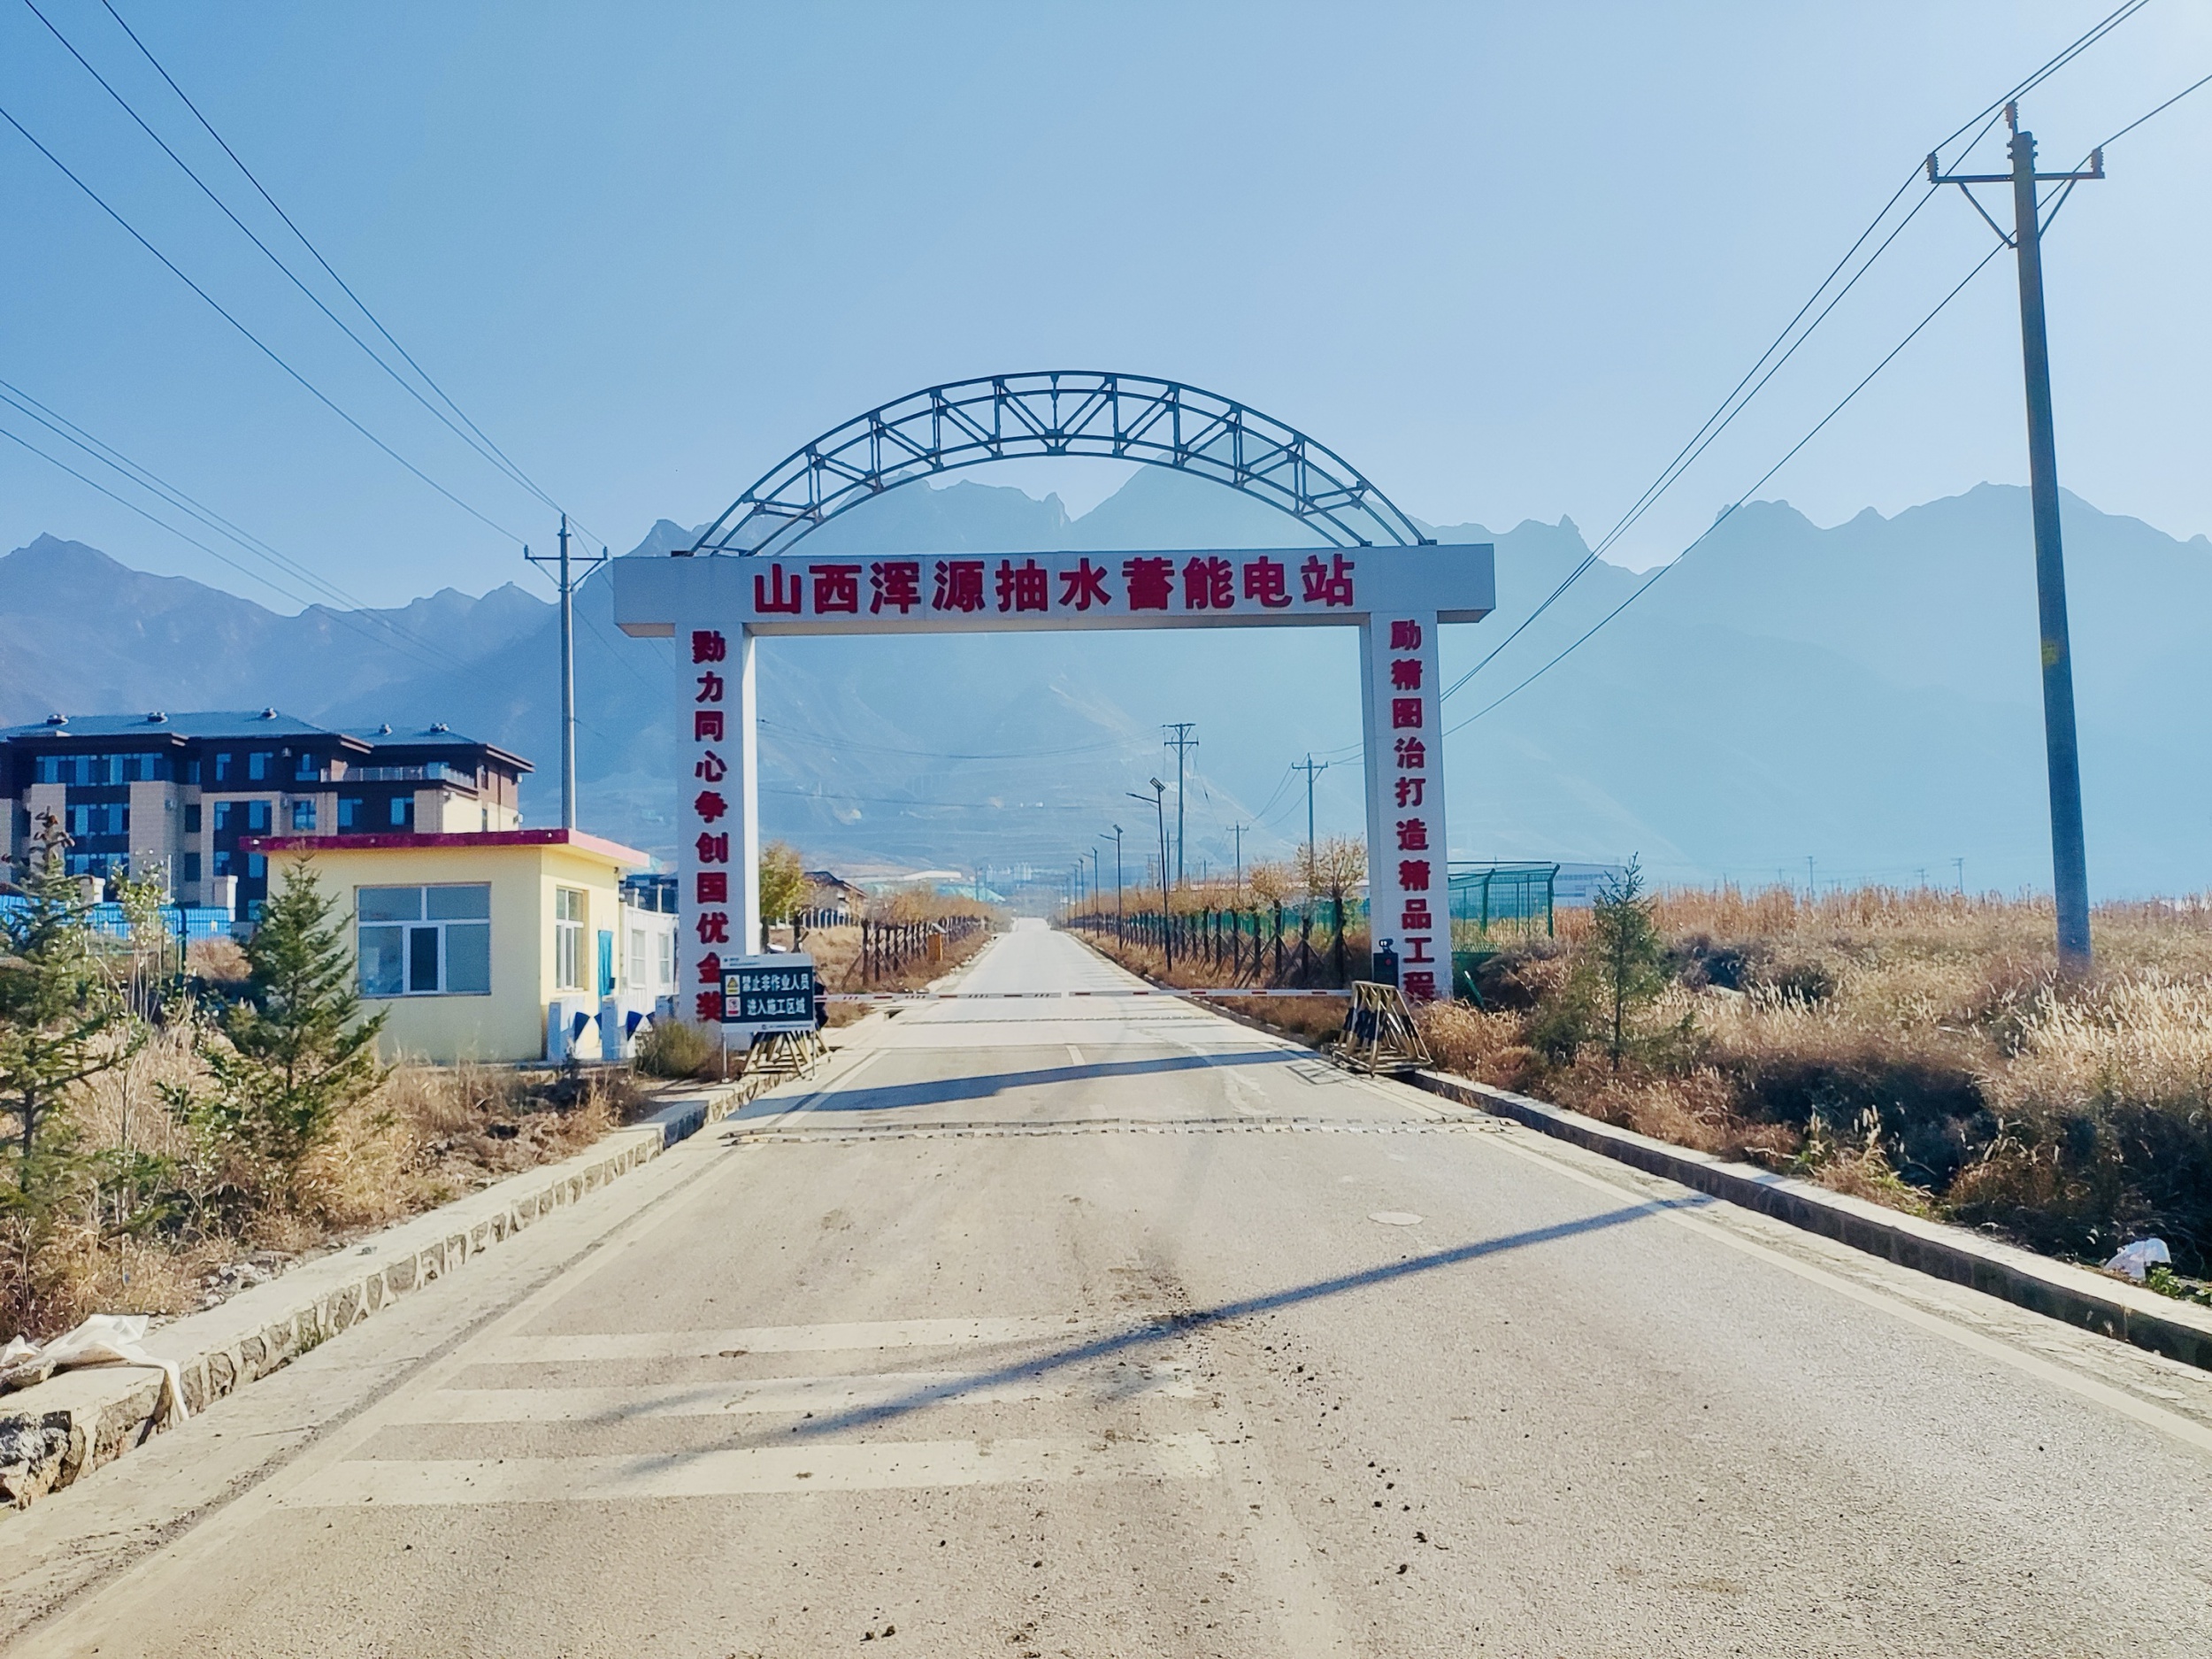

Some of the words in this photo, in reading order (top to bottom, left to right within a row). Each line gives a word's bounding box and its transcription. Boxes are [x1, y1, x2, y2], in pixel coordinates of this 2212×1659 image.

[754, 554, 1355, 614] 山西浑源抽水蓄能电站
[1390, 619, 1435, 1000] 励精图治打造精品工程
